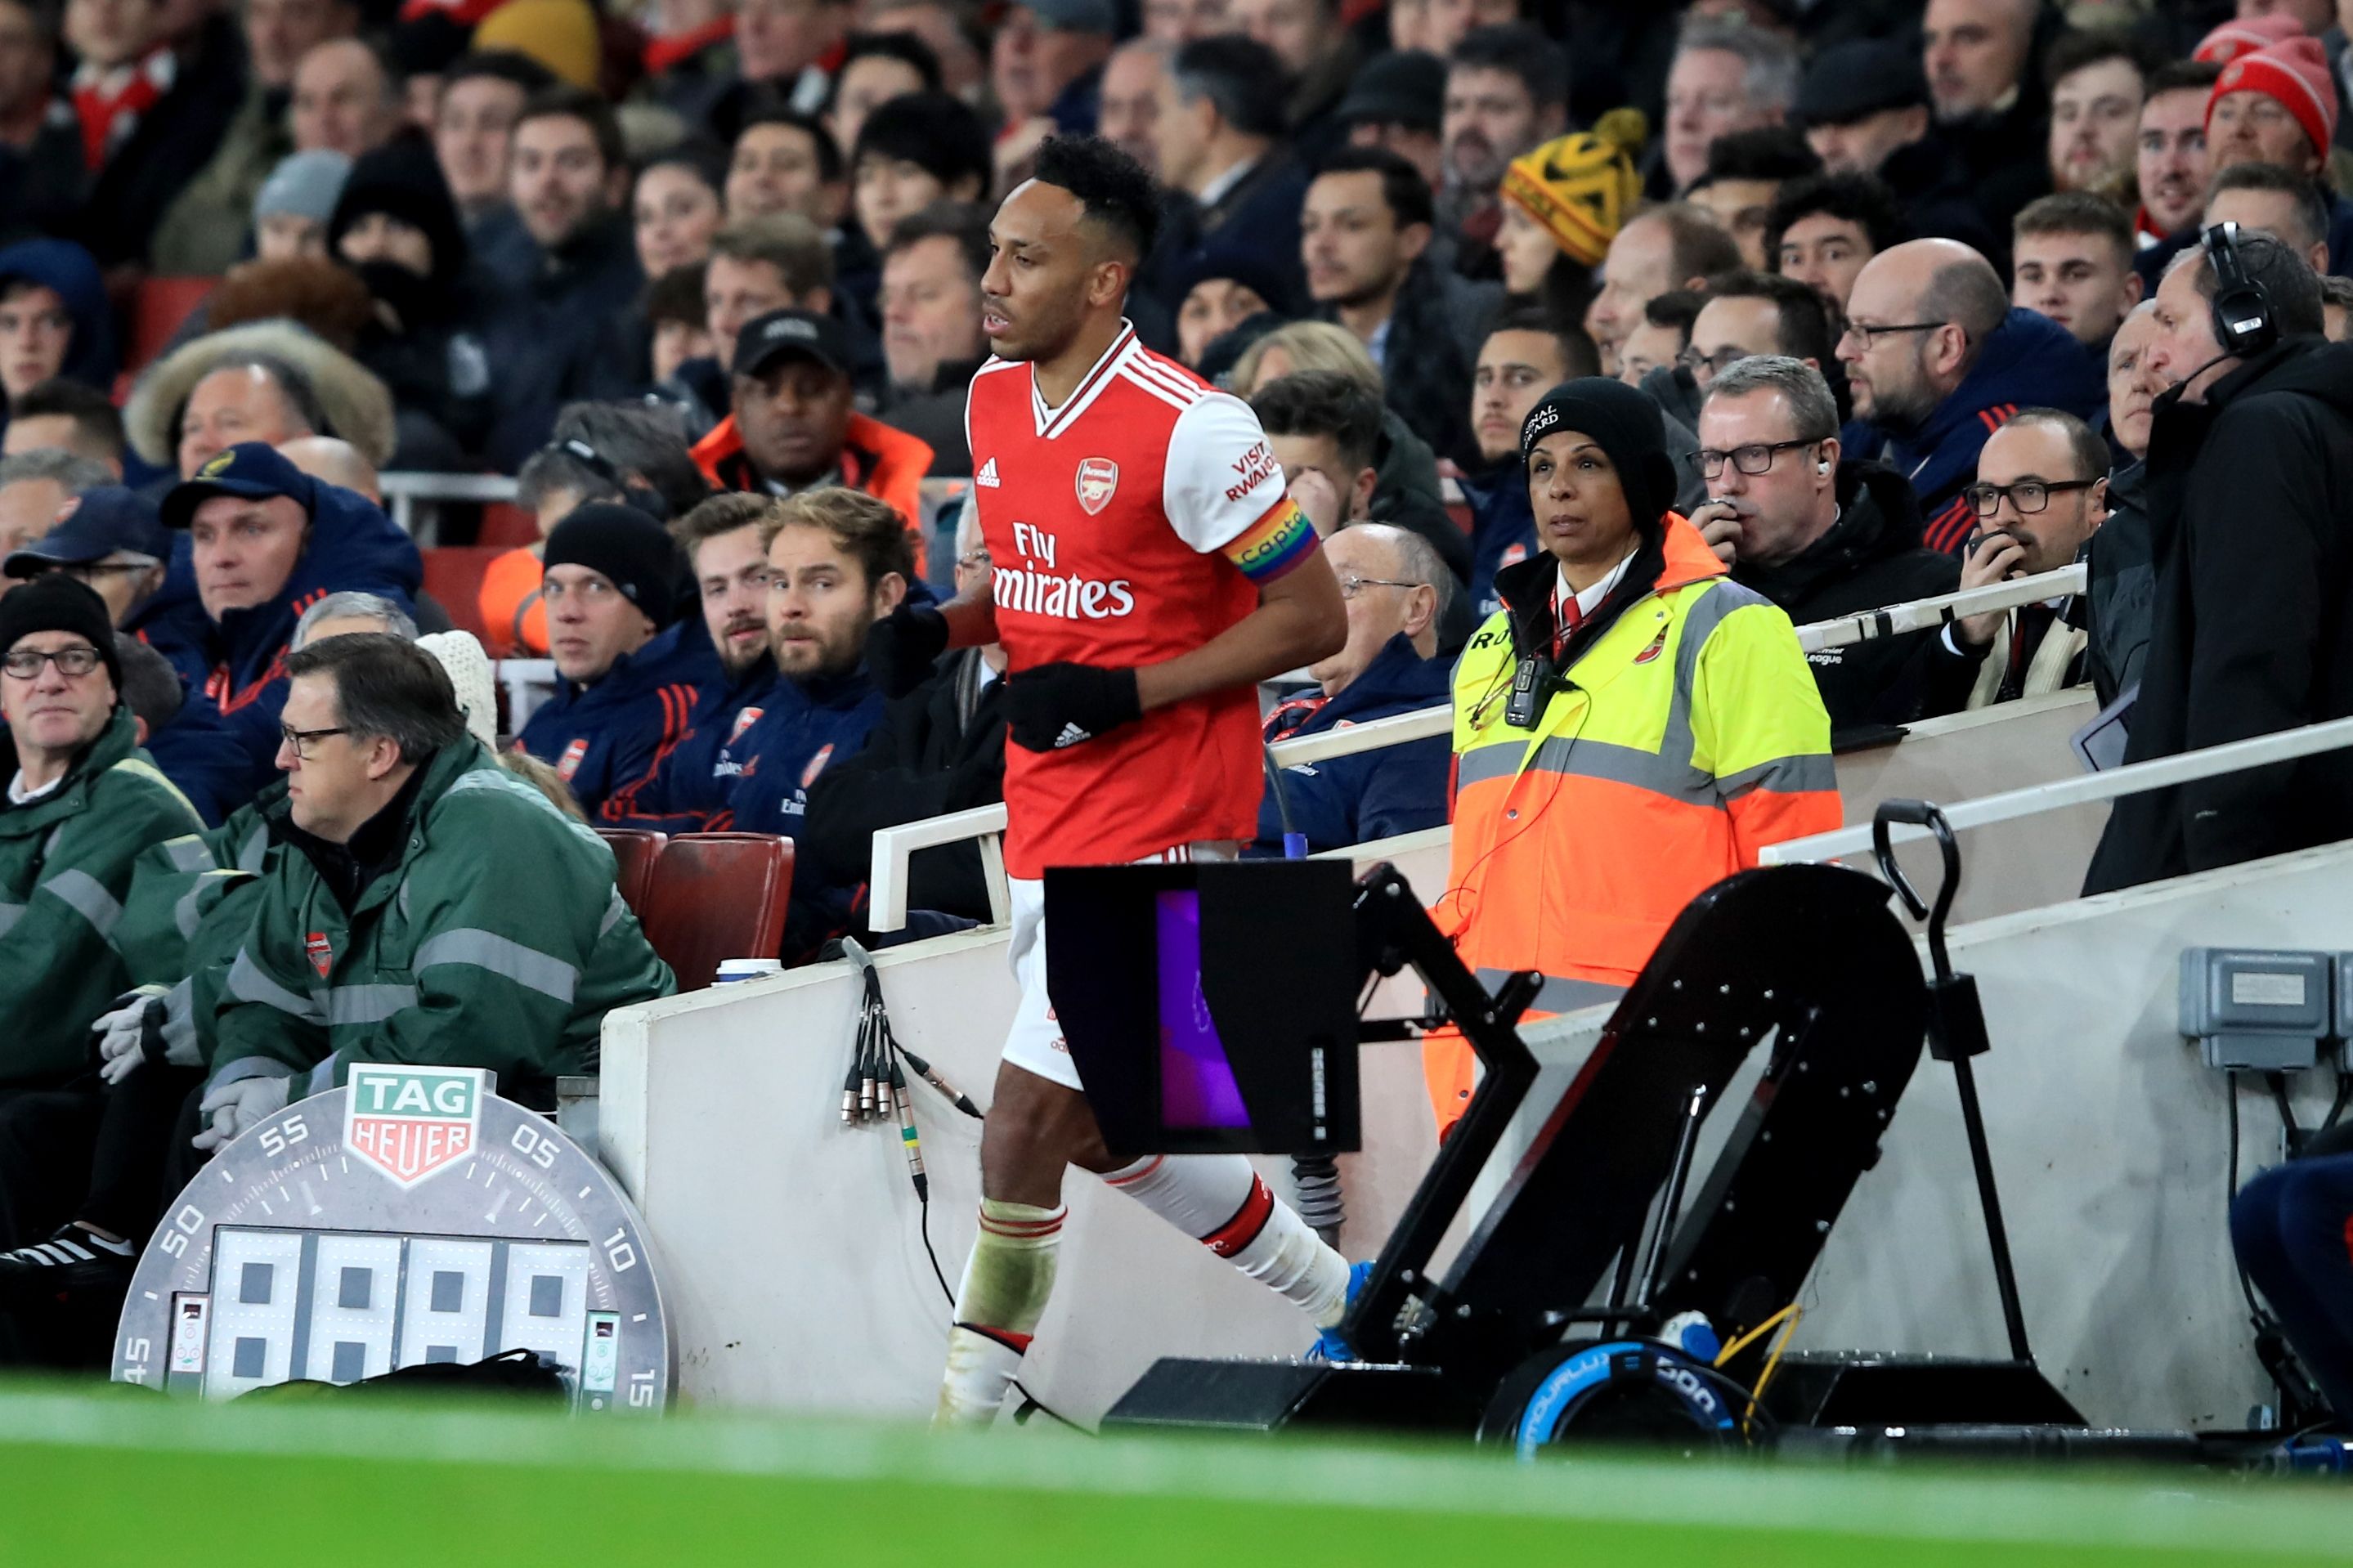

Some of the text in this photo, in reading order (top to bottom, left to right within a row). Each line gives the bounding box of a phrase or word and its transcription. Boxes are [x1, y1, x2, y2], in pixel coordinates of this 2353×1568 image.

[1232, 441, 1265, 474] VISIT
[976, 475, 1001, 488] adidas
[1012, 522, 1055, 569] Fly
[991, 559, 1134, 619] mirates
[1805, 653, 1843, 666] League
[362, 1077, 468, 1113] TAG
[258, 1114, 309, 1158] 55
[355, 1122, 468, 1176] HEUER
[511, 1123, 560, 1169] 05
[160, 1203, 204, 1259] 50
[603, 1227, 636, 1273] 10
[125, 1337, 150, 1384] 45
[629, 1369, 656, 1408] 15
